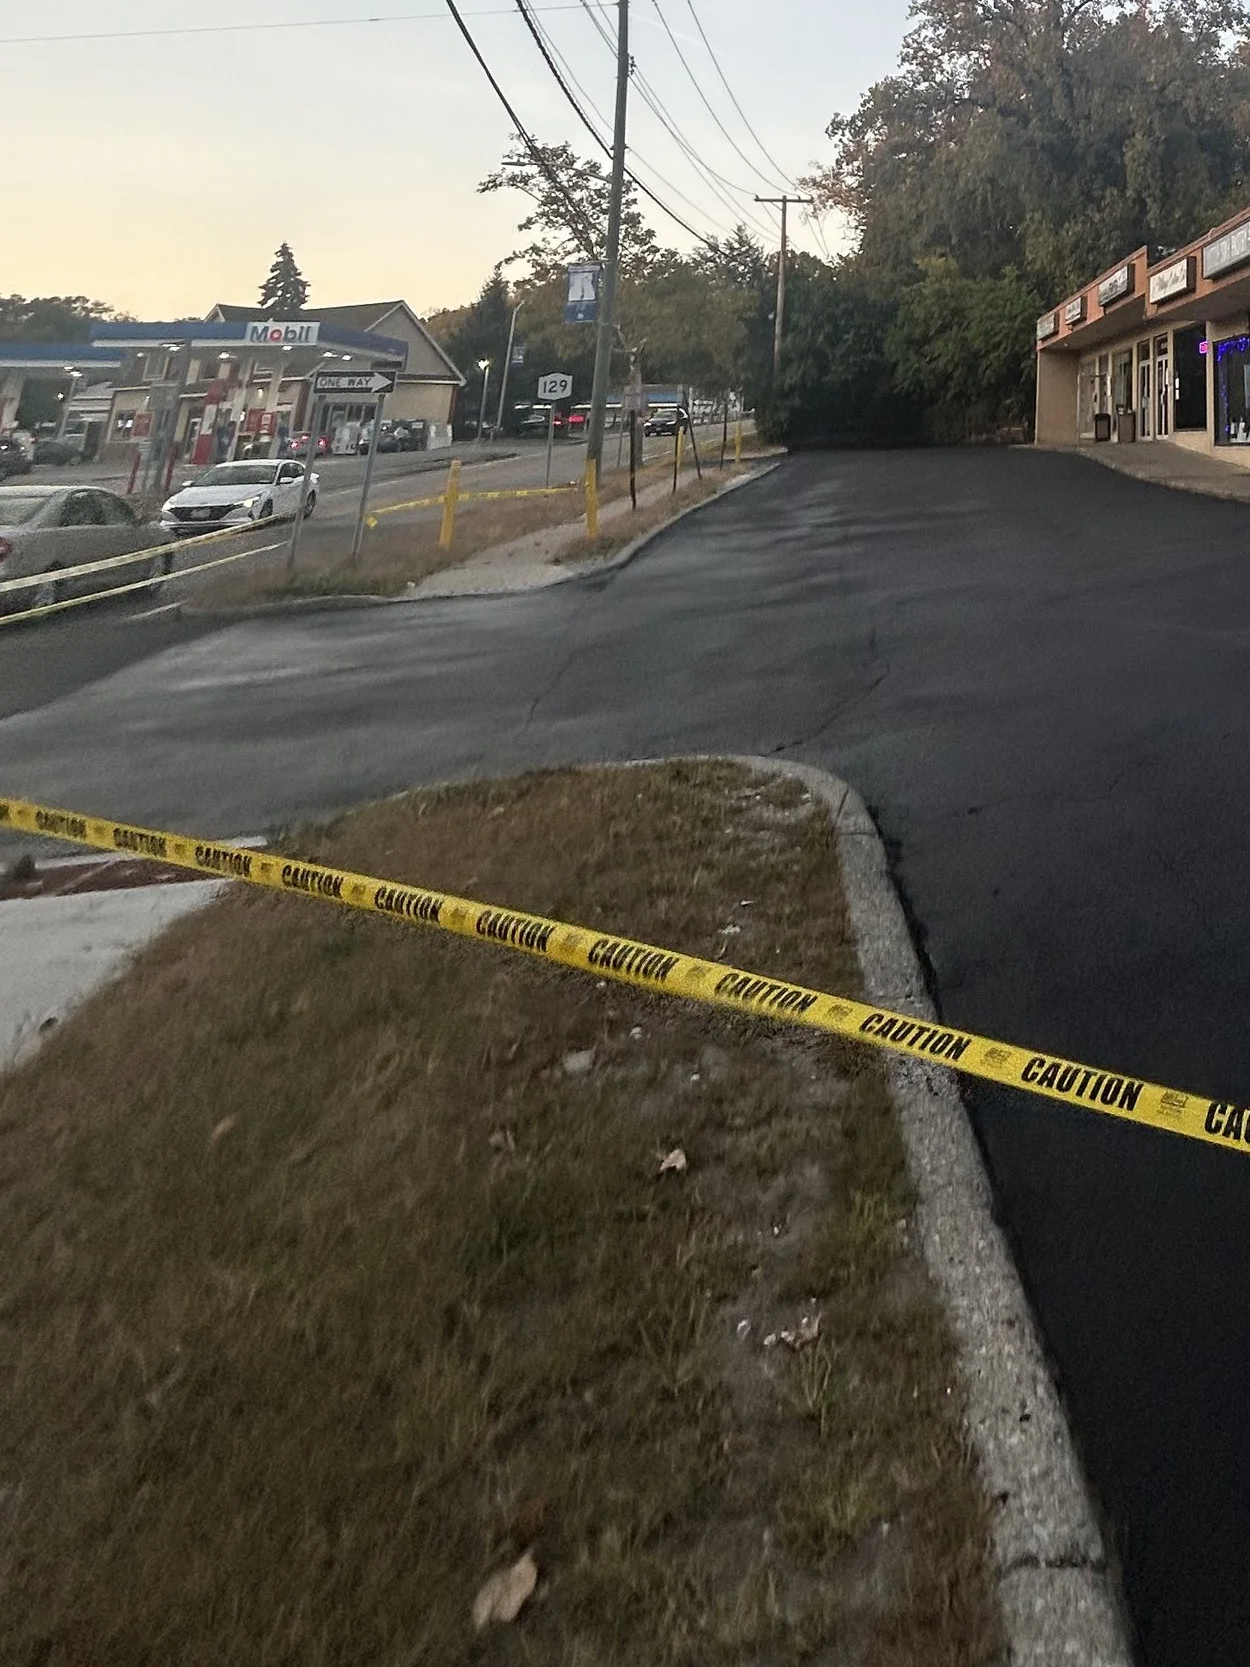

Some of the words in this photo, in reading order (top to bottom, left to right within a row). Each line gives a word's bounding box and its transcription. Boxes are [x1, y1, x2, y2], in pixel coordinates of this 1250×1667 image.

[250, 325, 312, 343] Mobil
[319, 377, 339, 387] ONE
[347, 377, 371, 387] WAY
[543, 379, 568, 394] 129
[113, 827, 167, 857] CAUTION
[195, 846, 252, 877] CAUTION
[282, 864, 344, 898] CAUTION
[374, 886, 443, 922] CAUTION
[475, 909, 555, 953] CAUTION
[588, 938, 679, 982] CAUTION
[713, 972, 819, 1013] CAUTION
[859, 1012, 972, 1062] CAUTION
[1020, 1056, 1144, 1111] CAUTION
